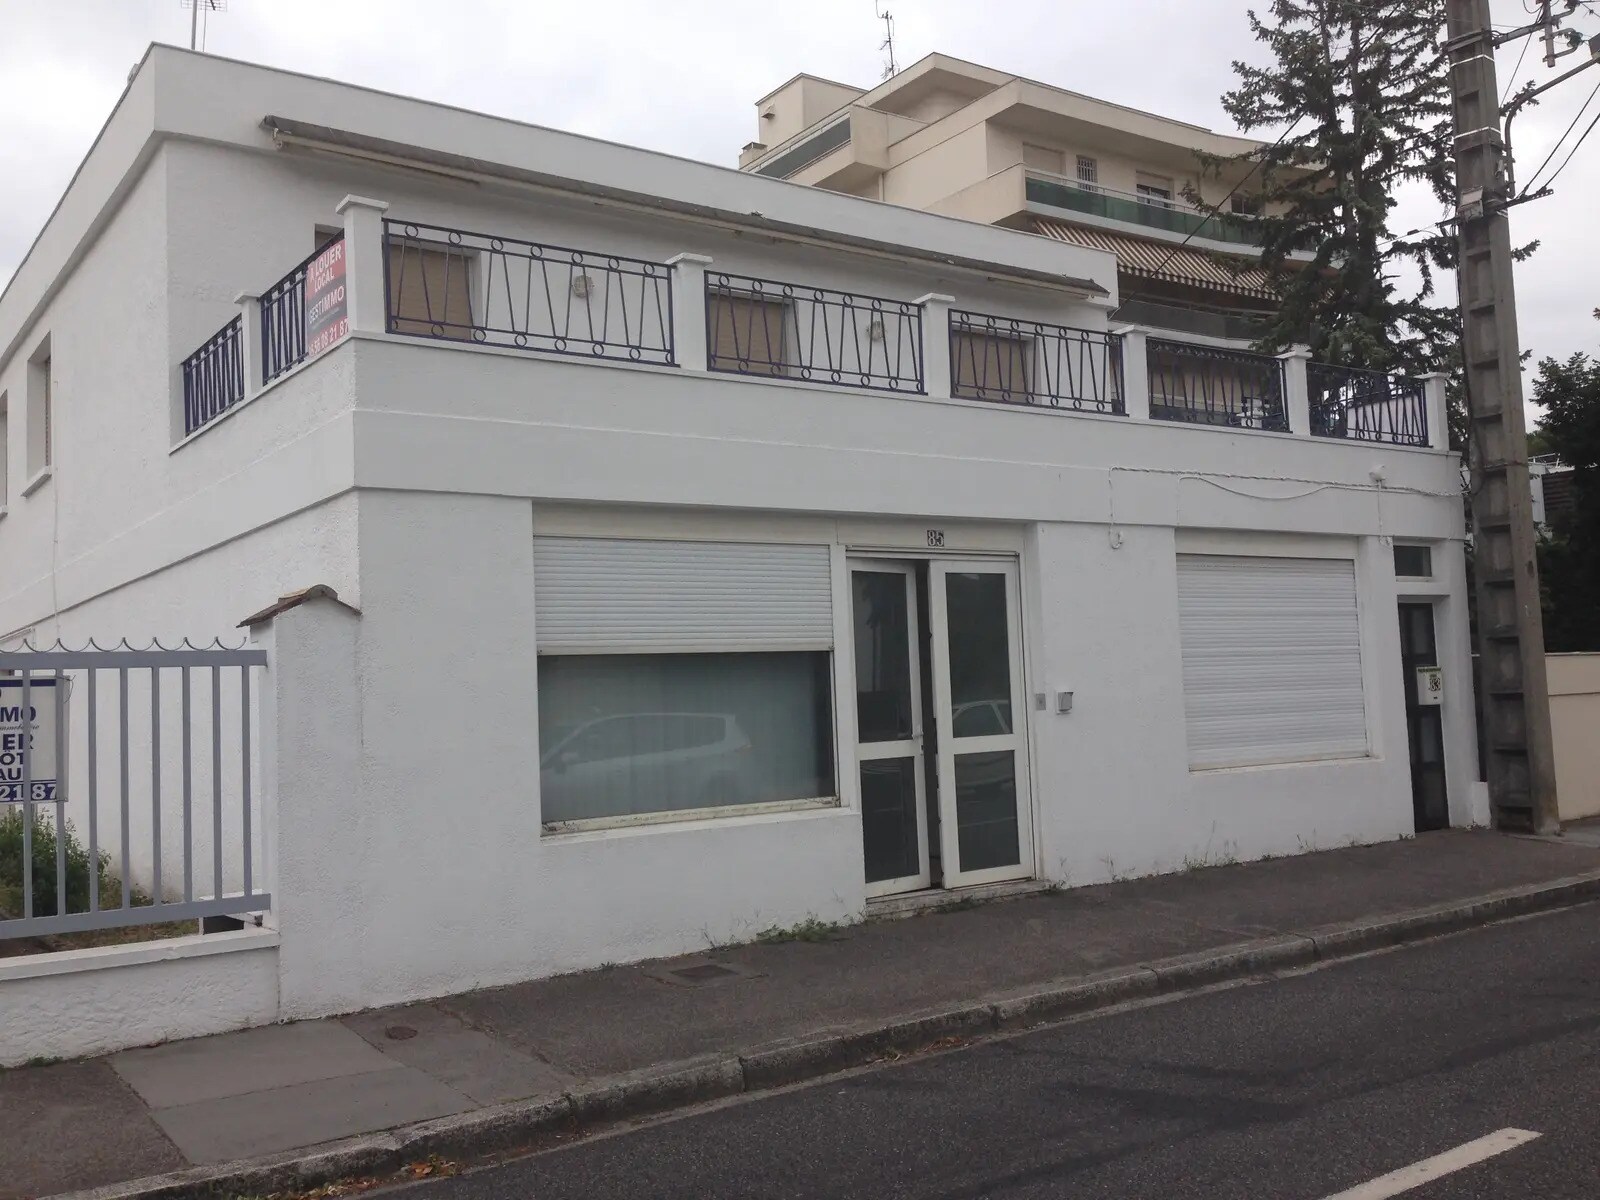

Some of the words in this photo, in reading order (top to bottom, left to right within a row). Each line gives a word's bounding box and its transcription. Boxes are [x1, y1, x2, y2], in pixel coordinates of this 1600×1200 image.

[315, 244, 342, 275] LOUER
[314, 268, 335, 293] LOCAL
[309, 286, 345, 324] GESTIMMO
[330, 325, 337, 343] 21
[340, 318, 349, 336] 87
[927, 530, 944, 546] 85
